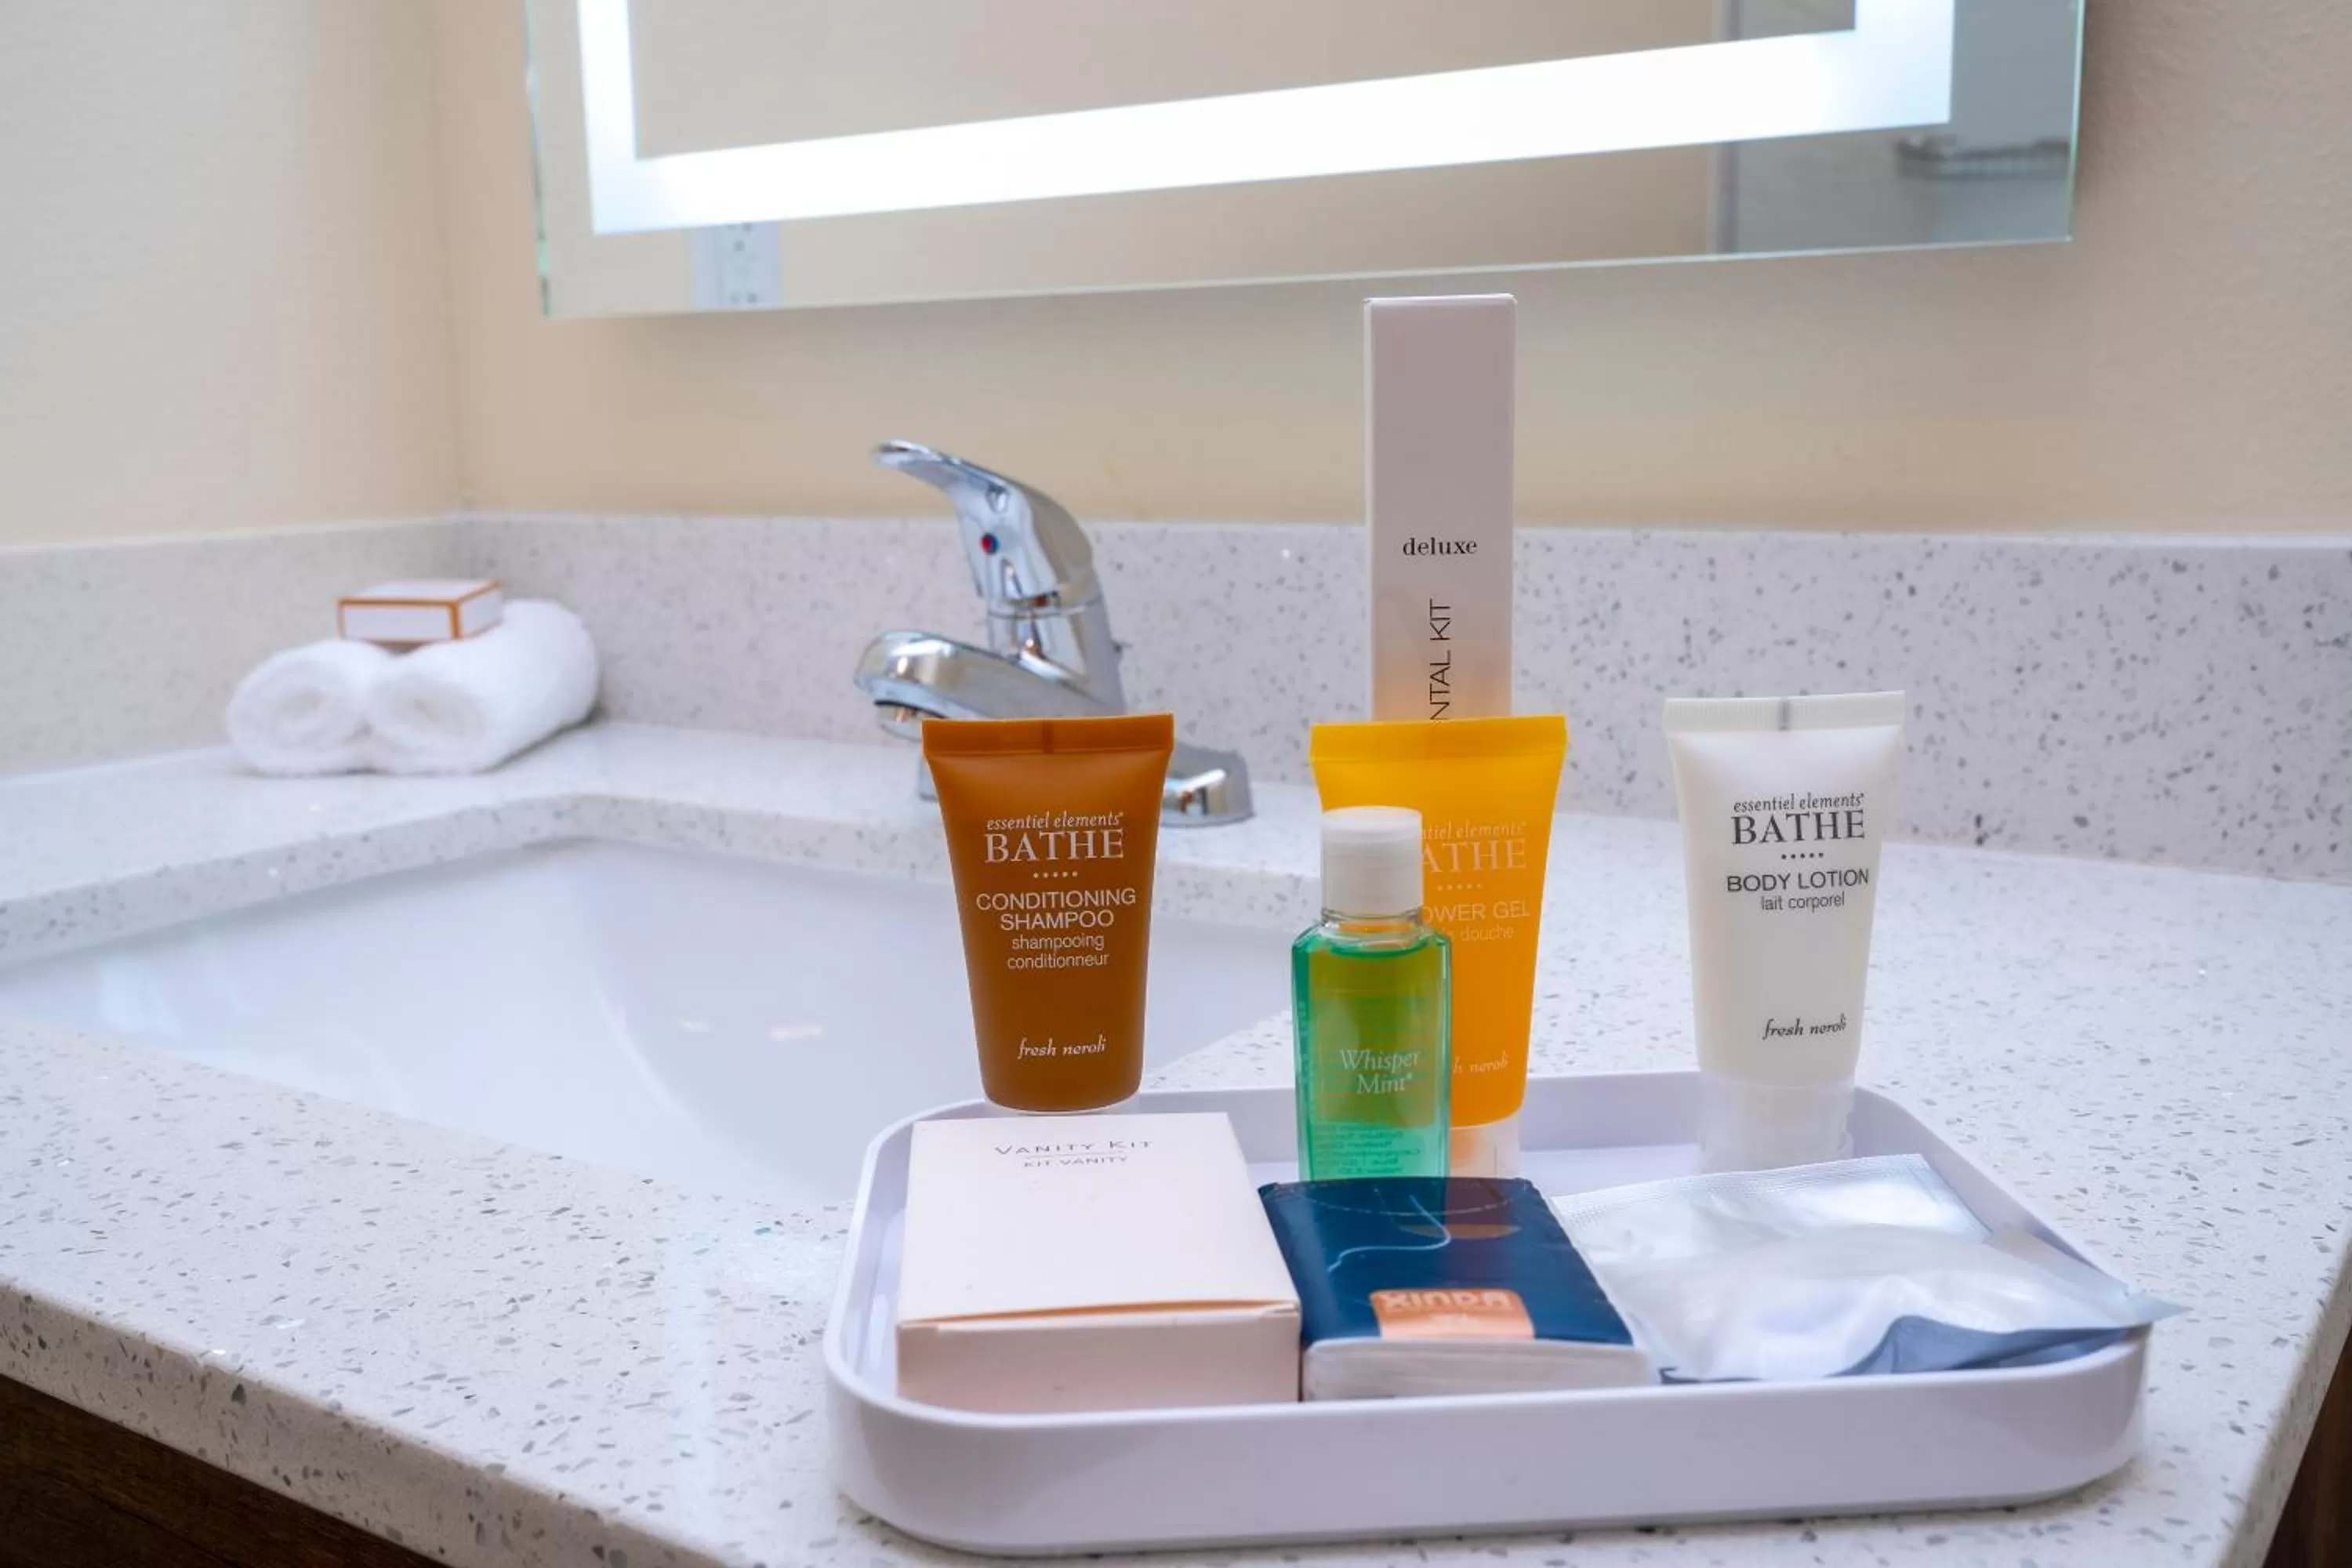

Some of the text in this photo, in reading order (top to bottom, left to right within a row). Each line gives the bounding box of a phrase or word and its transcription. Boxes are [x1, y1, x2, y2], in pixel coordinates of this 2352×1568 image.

[1402, 536, 1478, 556] deluxe
[1429, 598, 1451, 720] NTAL KIT
[1733, 793, 1795, 813] essentiel
[986, 810, 1051, 831] essentiel
[1730, 808, 1865, 845] BATHE
[985, 827, 1124, 864] BATHE
[1423, 837, 1528, 873] ATHE
[1726, 869, 1870, 893] BODY LOTION
[976, 887, 1137, 911] CONDITIONING
[1761, 891, 1846, 913] lait corporel
[1000, 909, 1115, 931] SHAMPOO
[1422, 900, 1531, 924] OWER GEL
[1011, 934, 1105, 953] shampooing
[1461, 923, 1515, 942] douche
[1007, 953, 1110, 971] conditionneur
[1762, 1017, 1804, 1041] fresh
[1018, 1033, 1107, 1060] fresh neroli
[1339, 1048, 1421, 1073] Whisper
[1356, 1072, 1406, 1096] Mint
[994, 1140, 1152, 1156] VANITY KIT
[1059, 1155, 1127, 1166] VANITY
